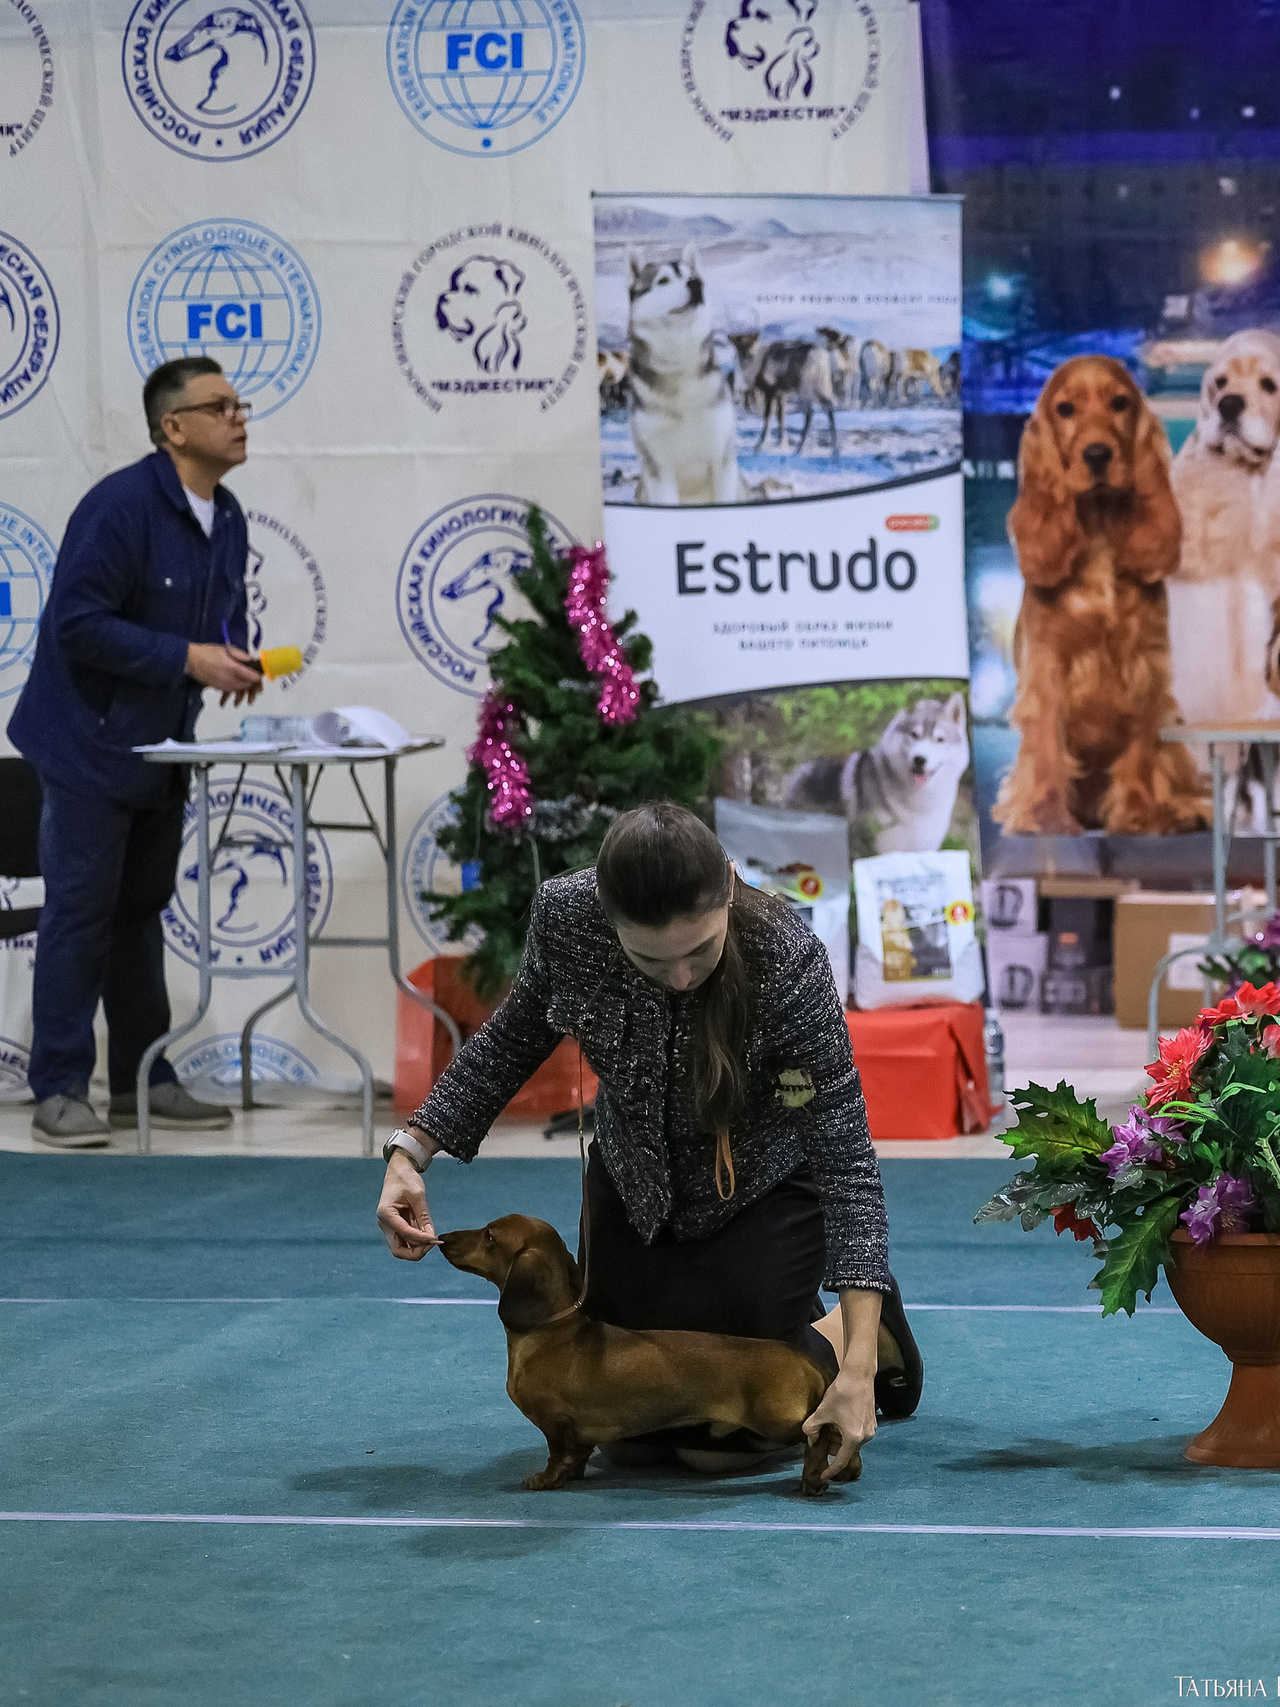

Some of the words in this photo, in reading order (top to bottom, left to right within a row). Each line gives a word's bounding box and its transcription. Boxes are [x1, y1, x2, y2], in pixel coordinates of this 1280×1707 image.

[446, 32, 523, 70] FCI
[187, 303, 262, 339] FCI
[676, 537, 917, 595] Estrudo
